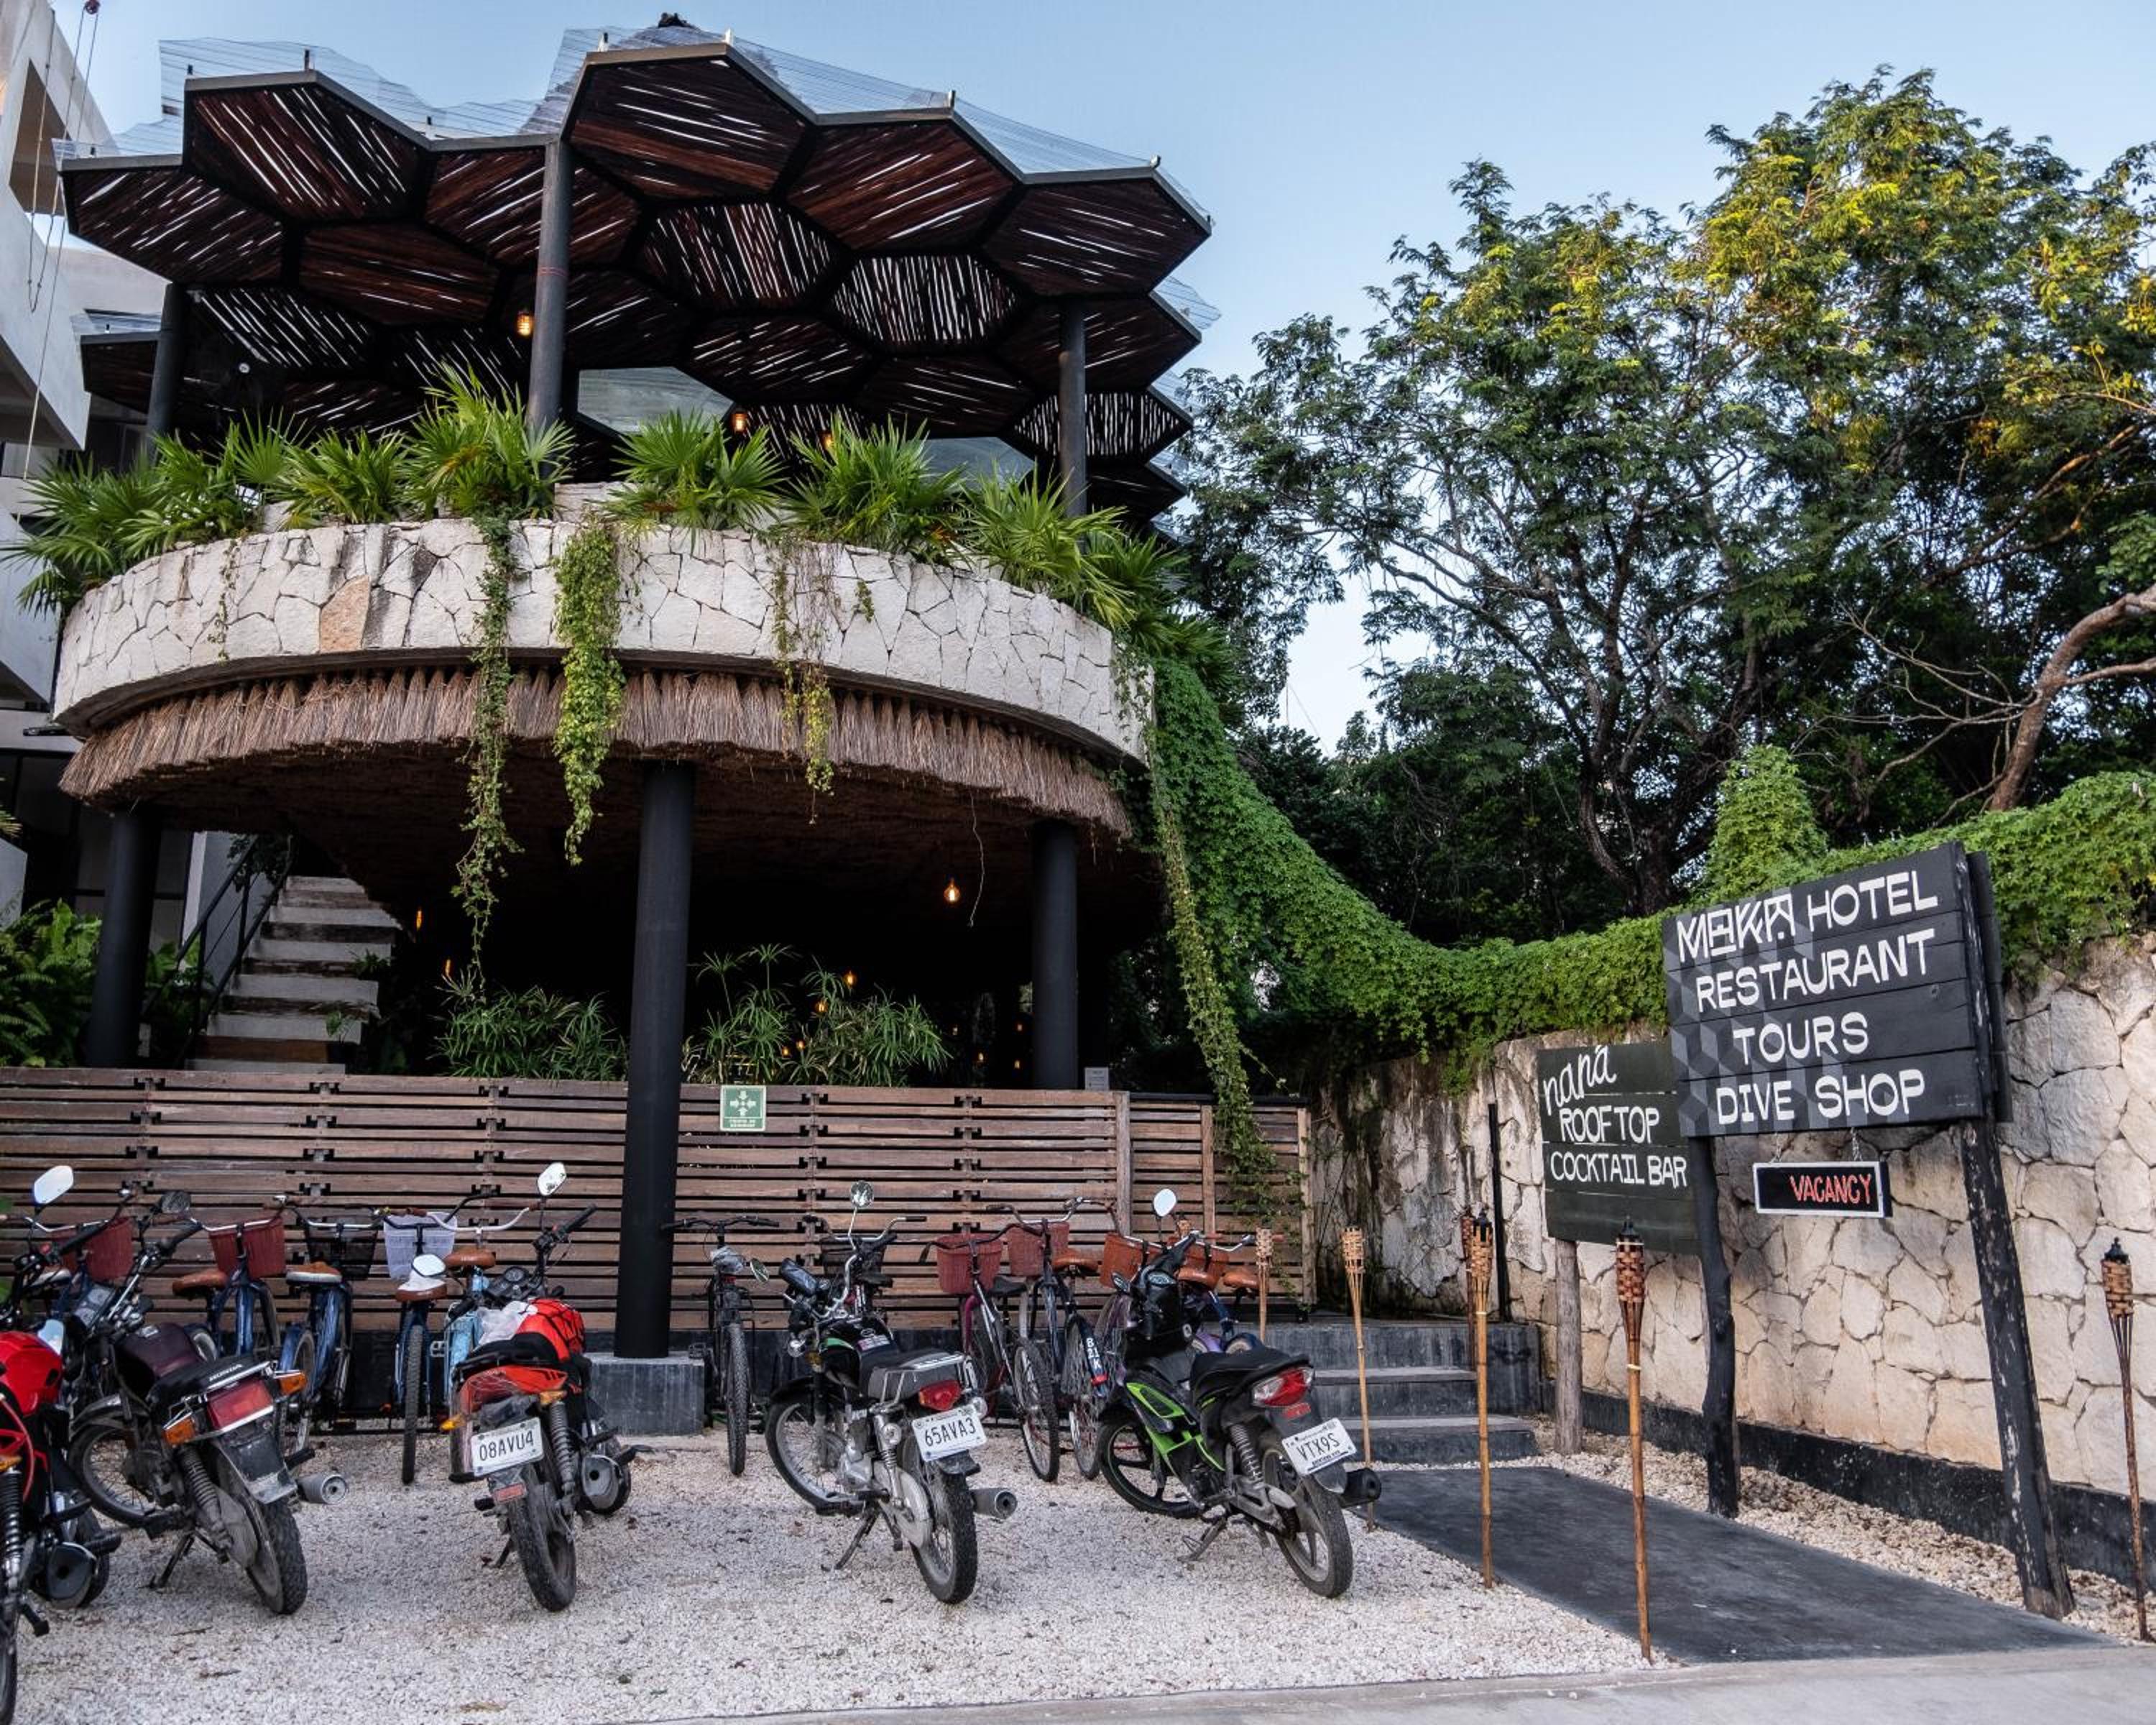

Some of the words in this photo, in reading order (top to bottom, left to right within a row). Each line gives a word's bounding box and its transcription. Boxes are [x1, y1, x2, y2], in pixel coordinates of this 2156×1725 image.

[1807, 870, 1938, 932] HOTEL
[1696, 928, 1935, 1013] RESTAURANT
[1733, 1011, 1869, 1065] TOURS
[1716, 1080, 1795, 1125] DIVE
[1815, 1069, 1925, 1119] SHOP
[1559, 1105, 1660, 1144] ROOFTOP
[1550, 1151, 1645, 1184] COCKTAIL
[1647, 1155, 1687, 1190] BAR
[1789, 1174, 1871, 1205] VACANCY
[479, 1430, 534, 1461] 08AVU4
[925, 1417, 976, 1447] 65AVA3
